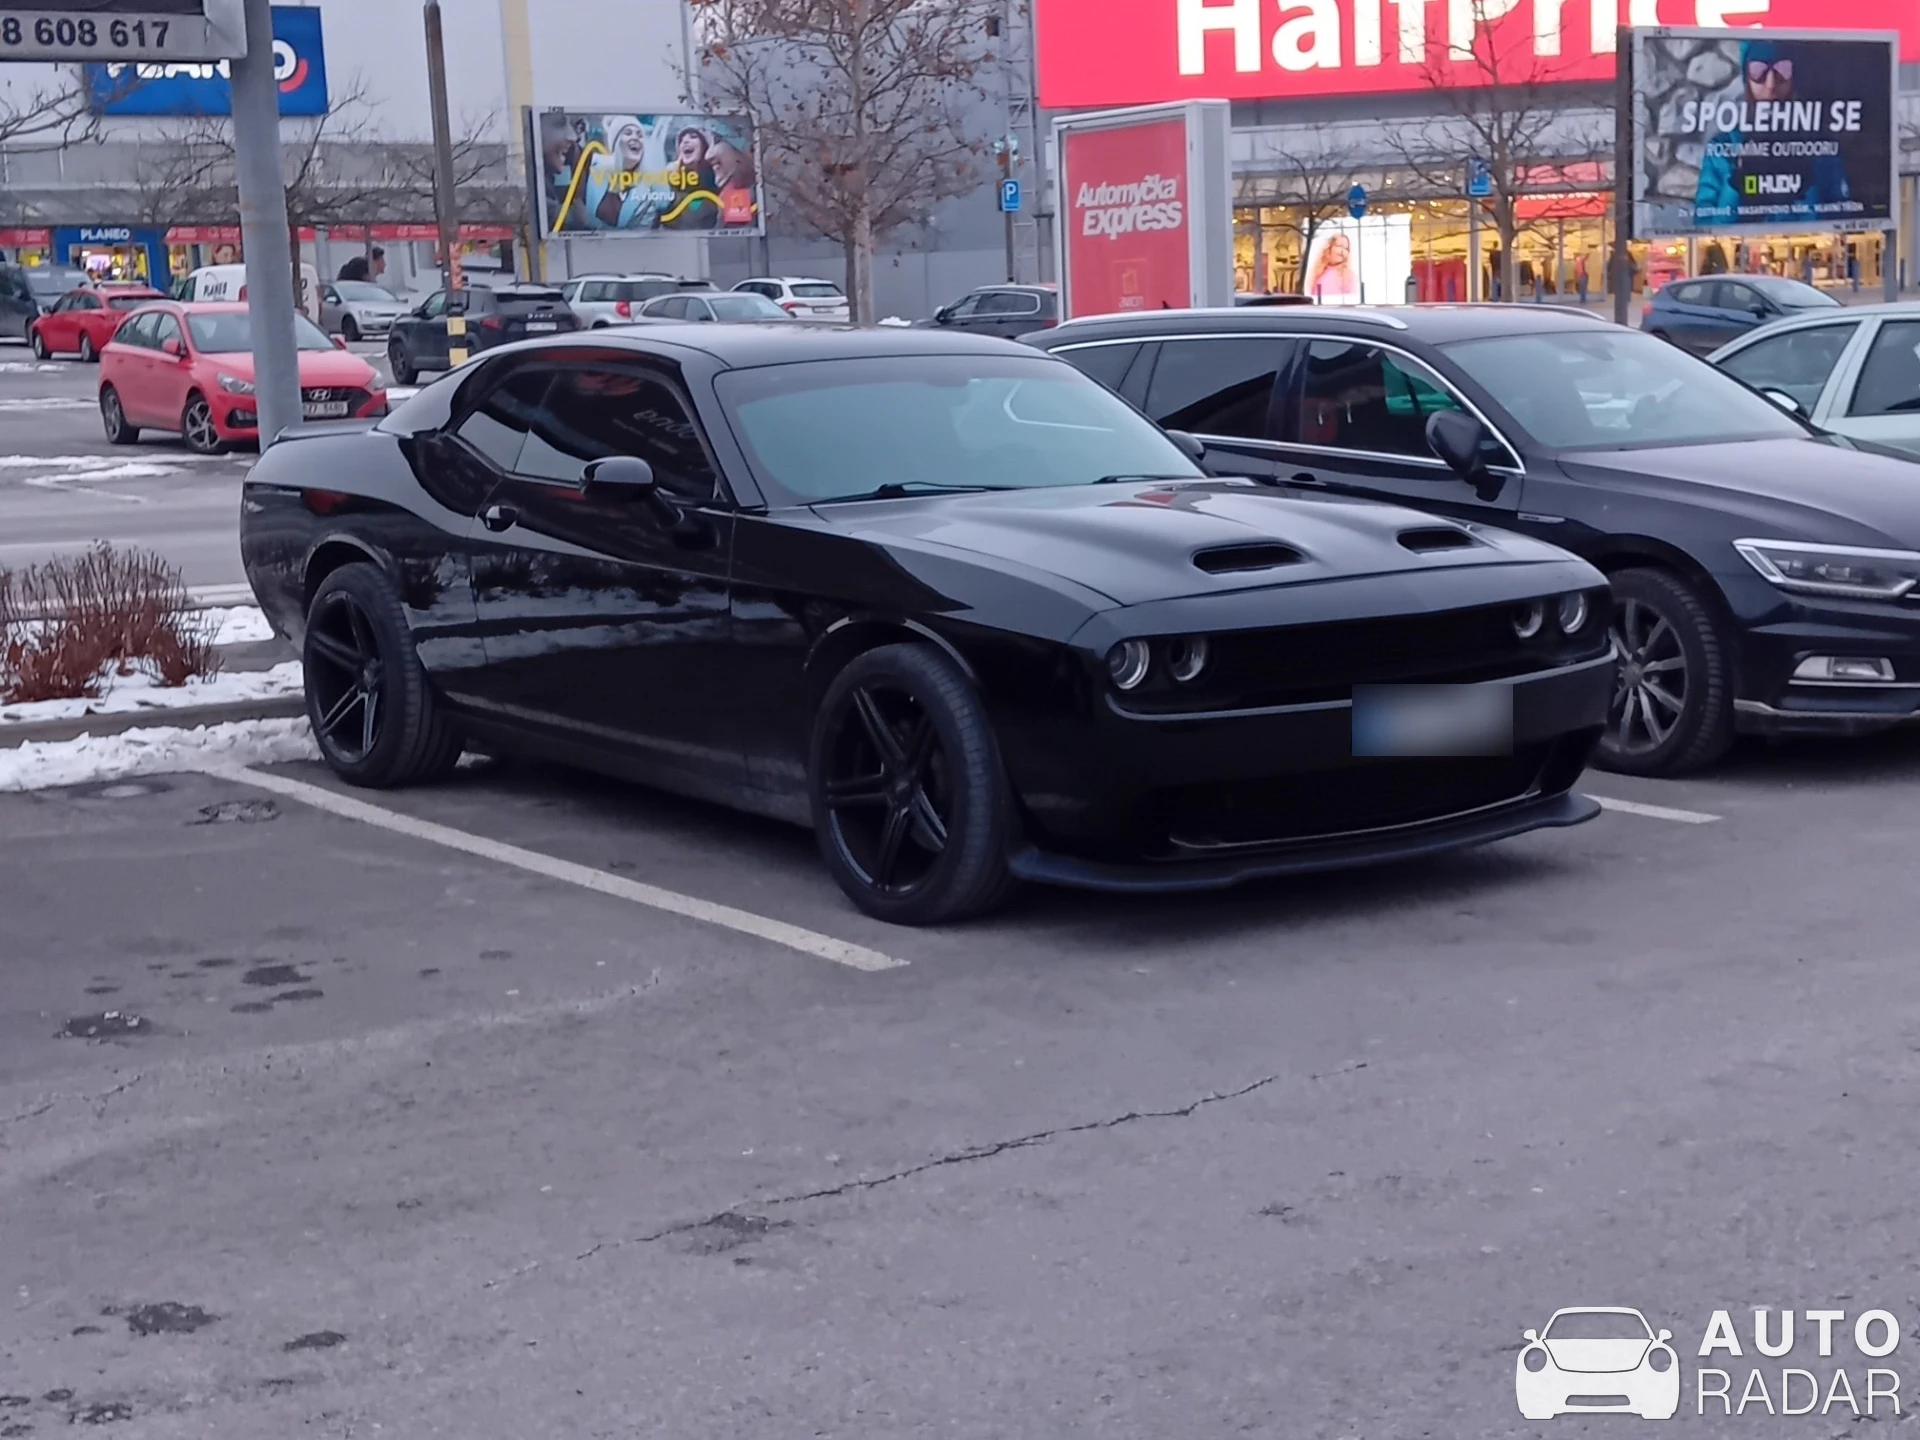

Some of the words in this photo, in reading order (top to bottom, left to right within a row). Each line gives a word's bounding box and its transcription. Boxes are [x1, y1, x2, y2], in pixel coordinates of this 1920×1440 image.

[34, 18, 98, 46] 608
[109, 19, 170, 48] 617
[1681, 101, 1822, 134] SPOLEHNI
[1829, 101, 1862, 132] SE
[1772, 141, 1839, 156] OUTDOORU
[1005, 182, 1017, 201] P
[1075, 174, 1178, 208] Automyčka
[80, 228, 130, 241] PLANEO
[1083, 201, 1183, 240] Express
